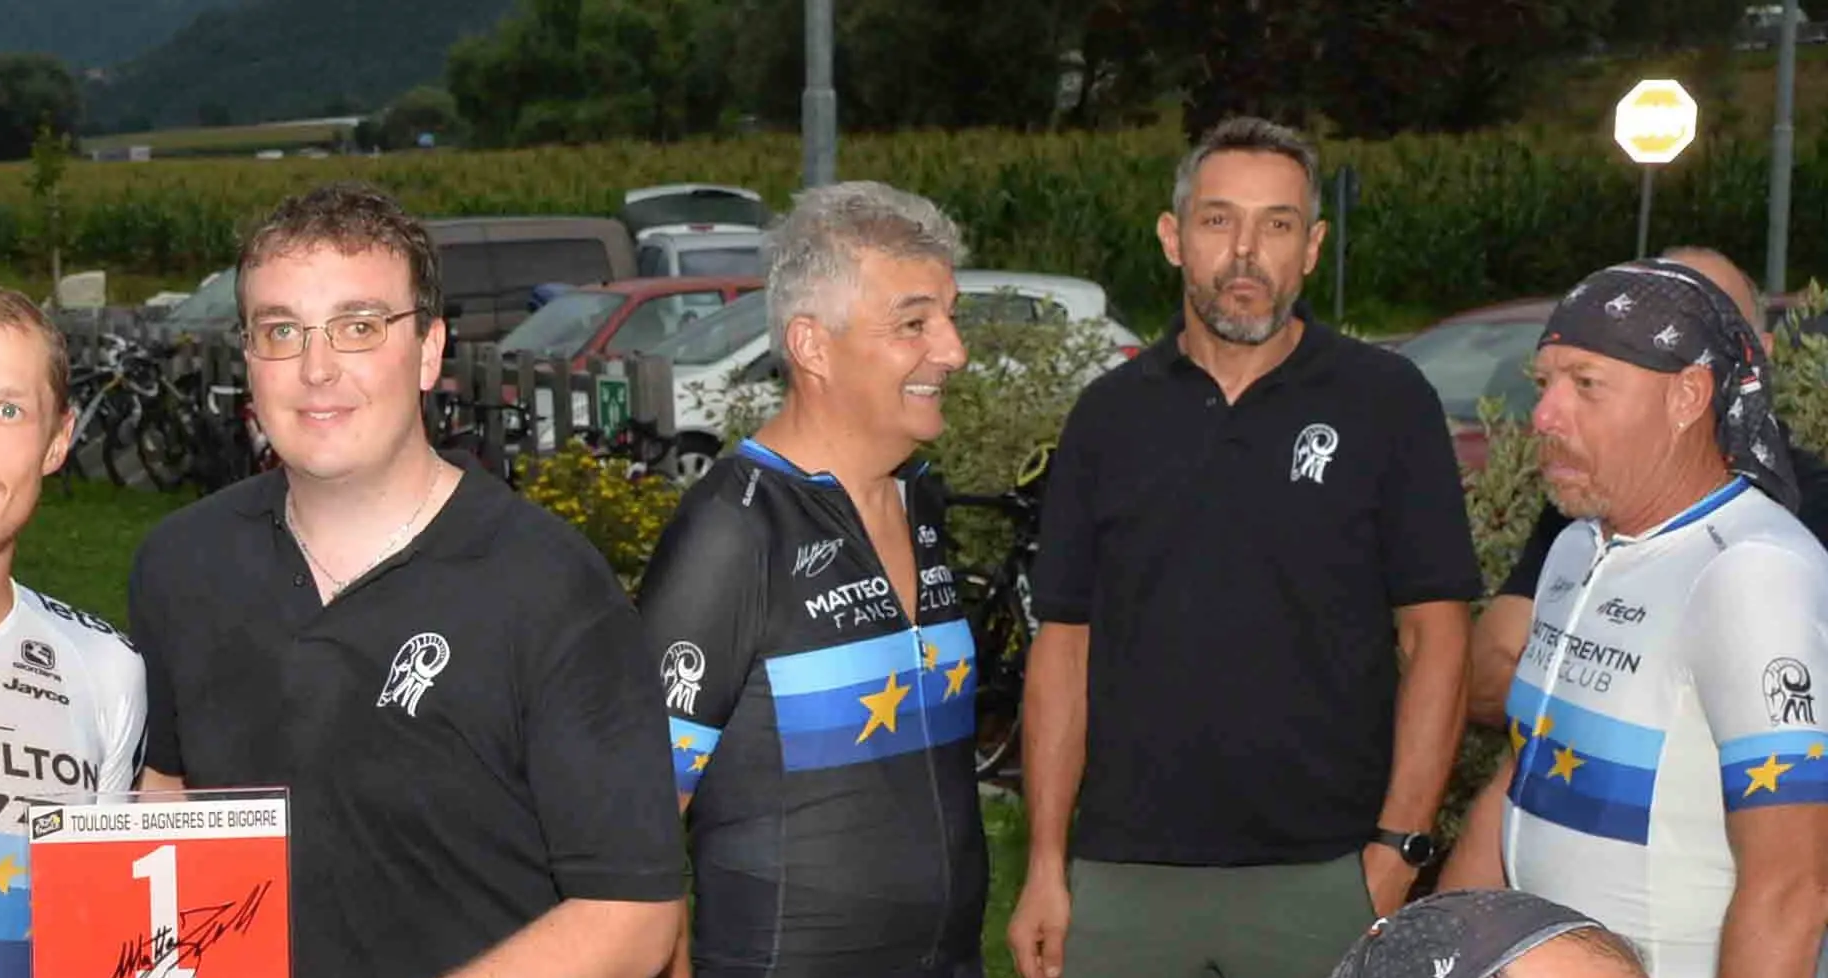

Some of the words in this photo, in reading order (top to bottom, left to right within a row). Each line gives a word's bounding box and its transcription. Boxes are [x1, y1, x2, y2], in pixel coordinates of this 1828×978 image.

[805, 576, 889, 619] MATTEO
[3, 678, 70, 705] Jayco
[71, 813, 131, 832] TOULOUSE
[141, 811, 205, 830] BAGNERES
[208, 810, 224, 828] DE
[227, 808, 277, 827] BIGORRE
